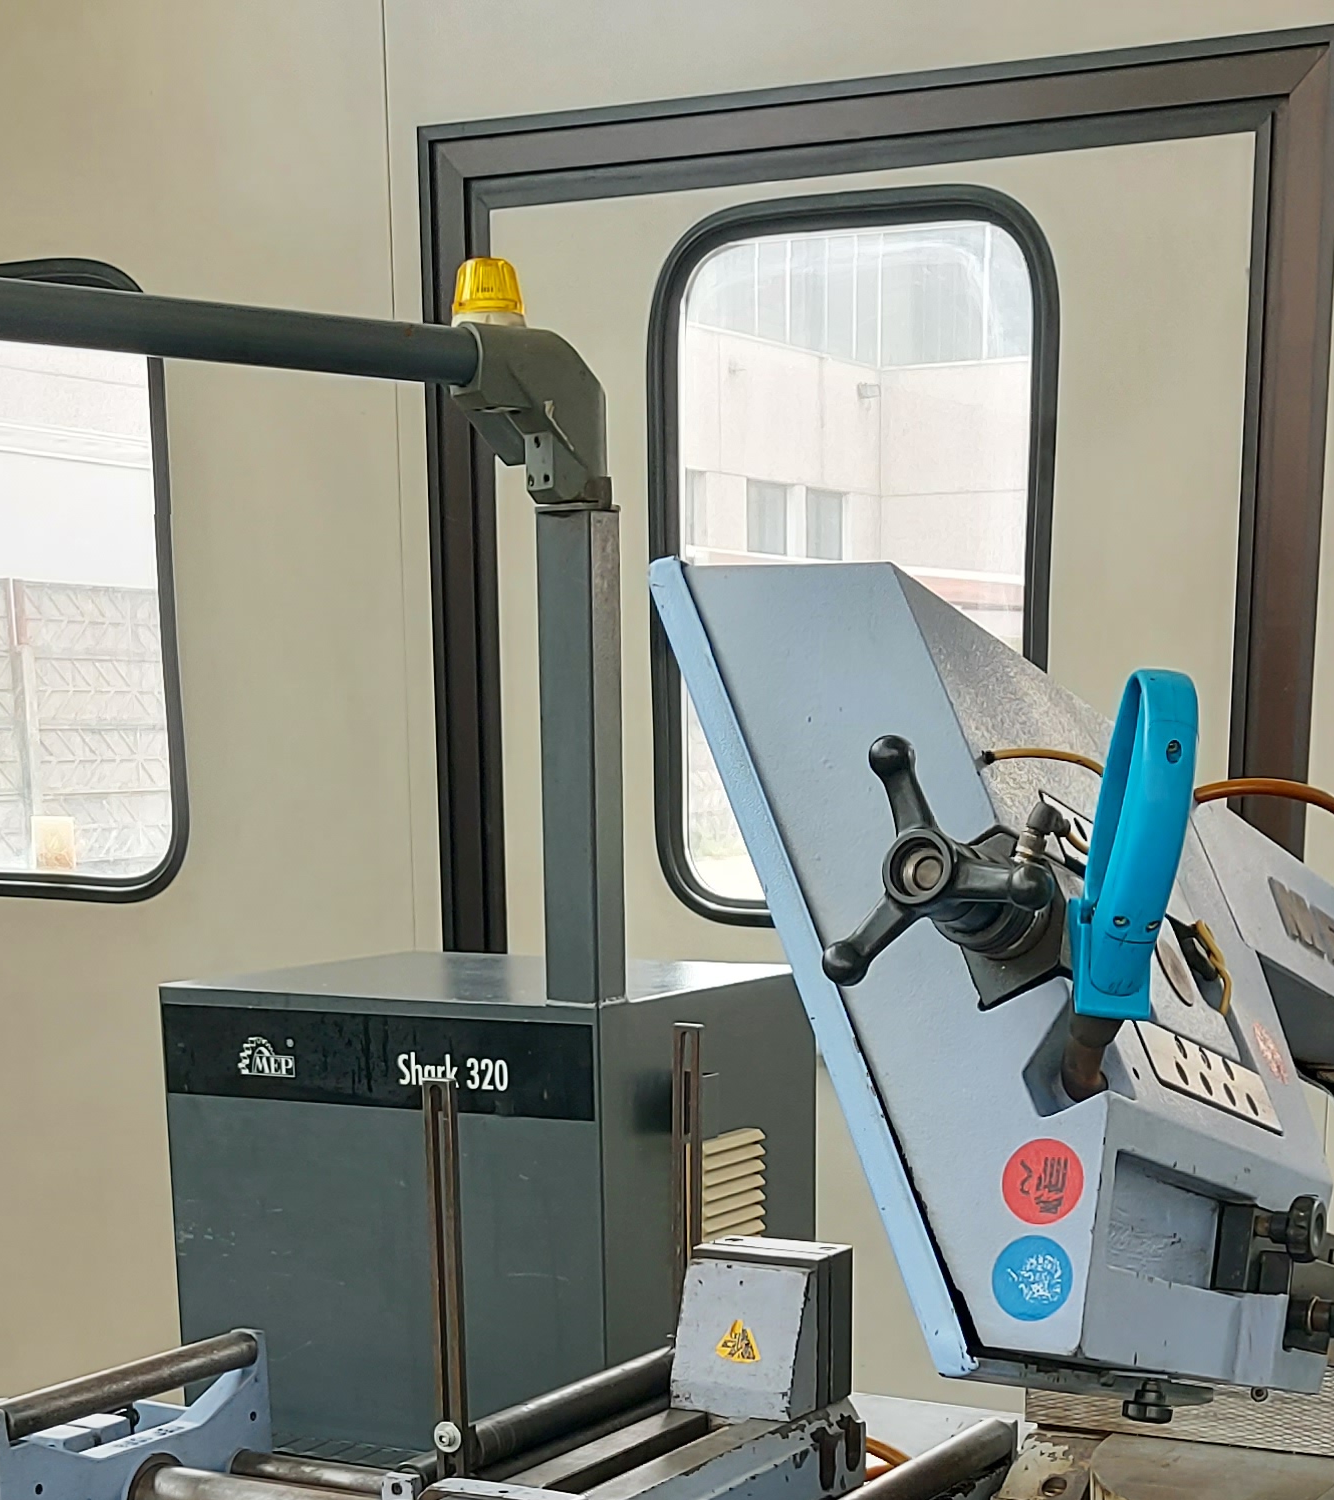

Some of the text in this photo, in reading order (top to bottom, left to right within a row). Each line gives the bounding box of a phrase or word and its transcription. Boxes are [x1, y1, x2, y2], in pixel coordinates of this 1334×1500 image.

[253, 1054, 294, 1075] MEP
[397, 1051, 509, 1091] Shark 320
